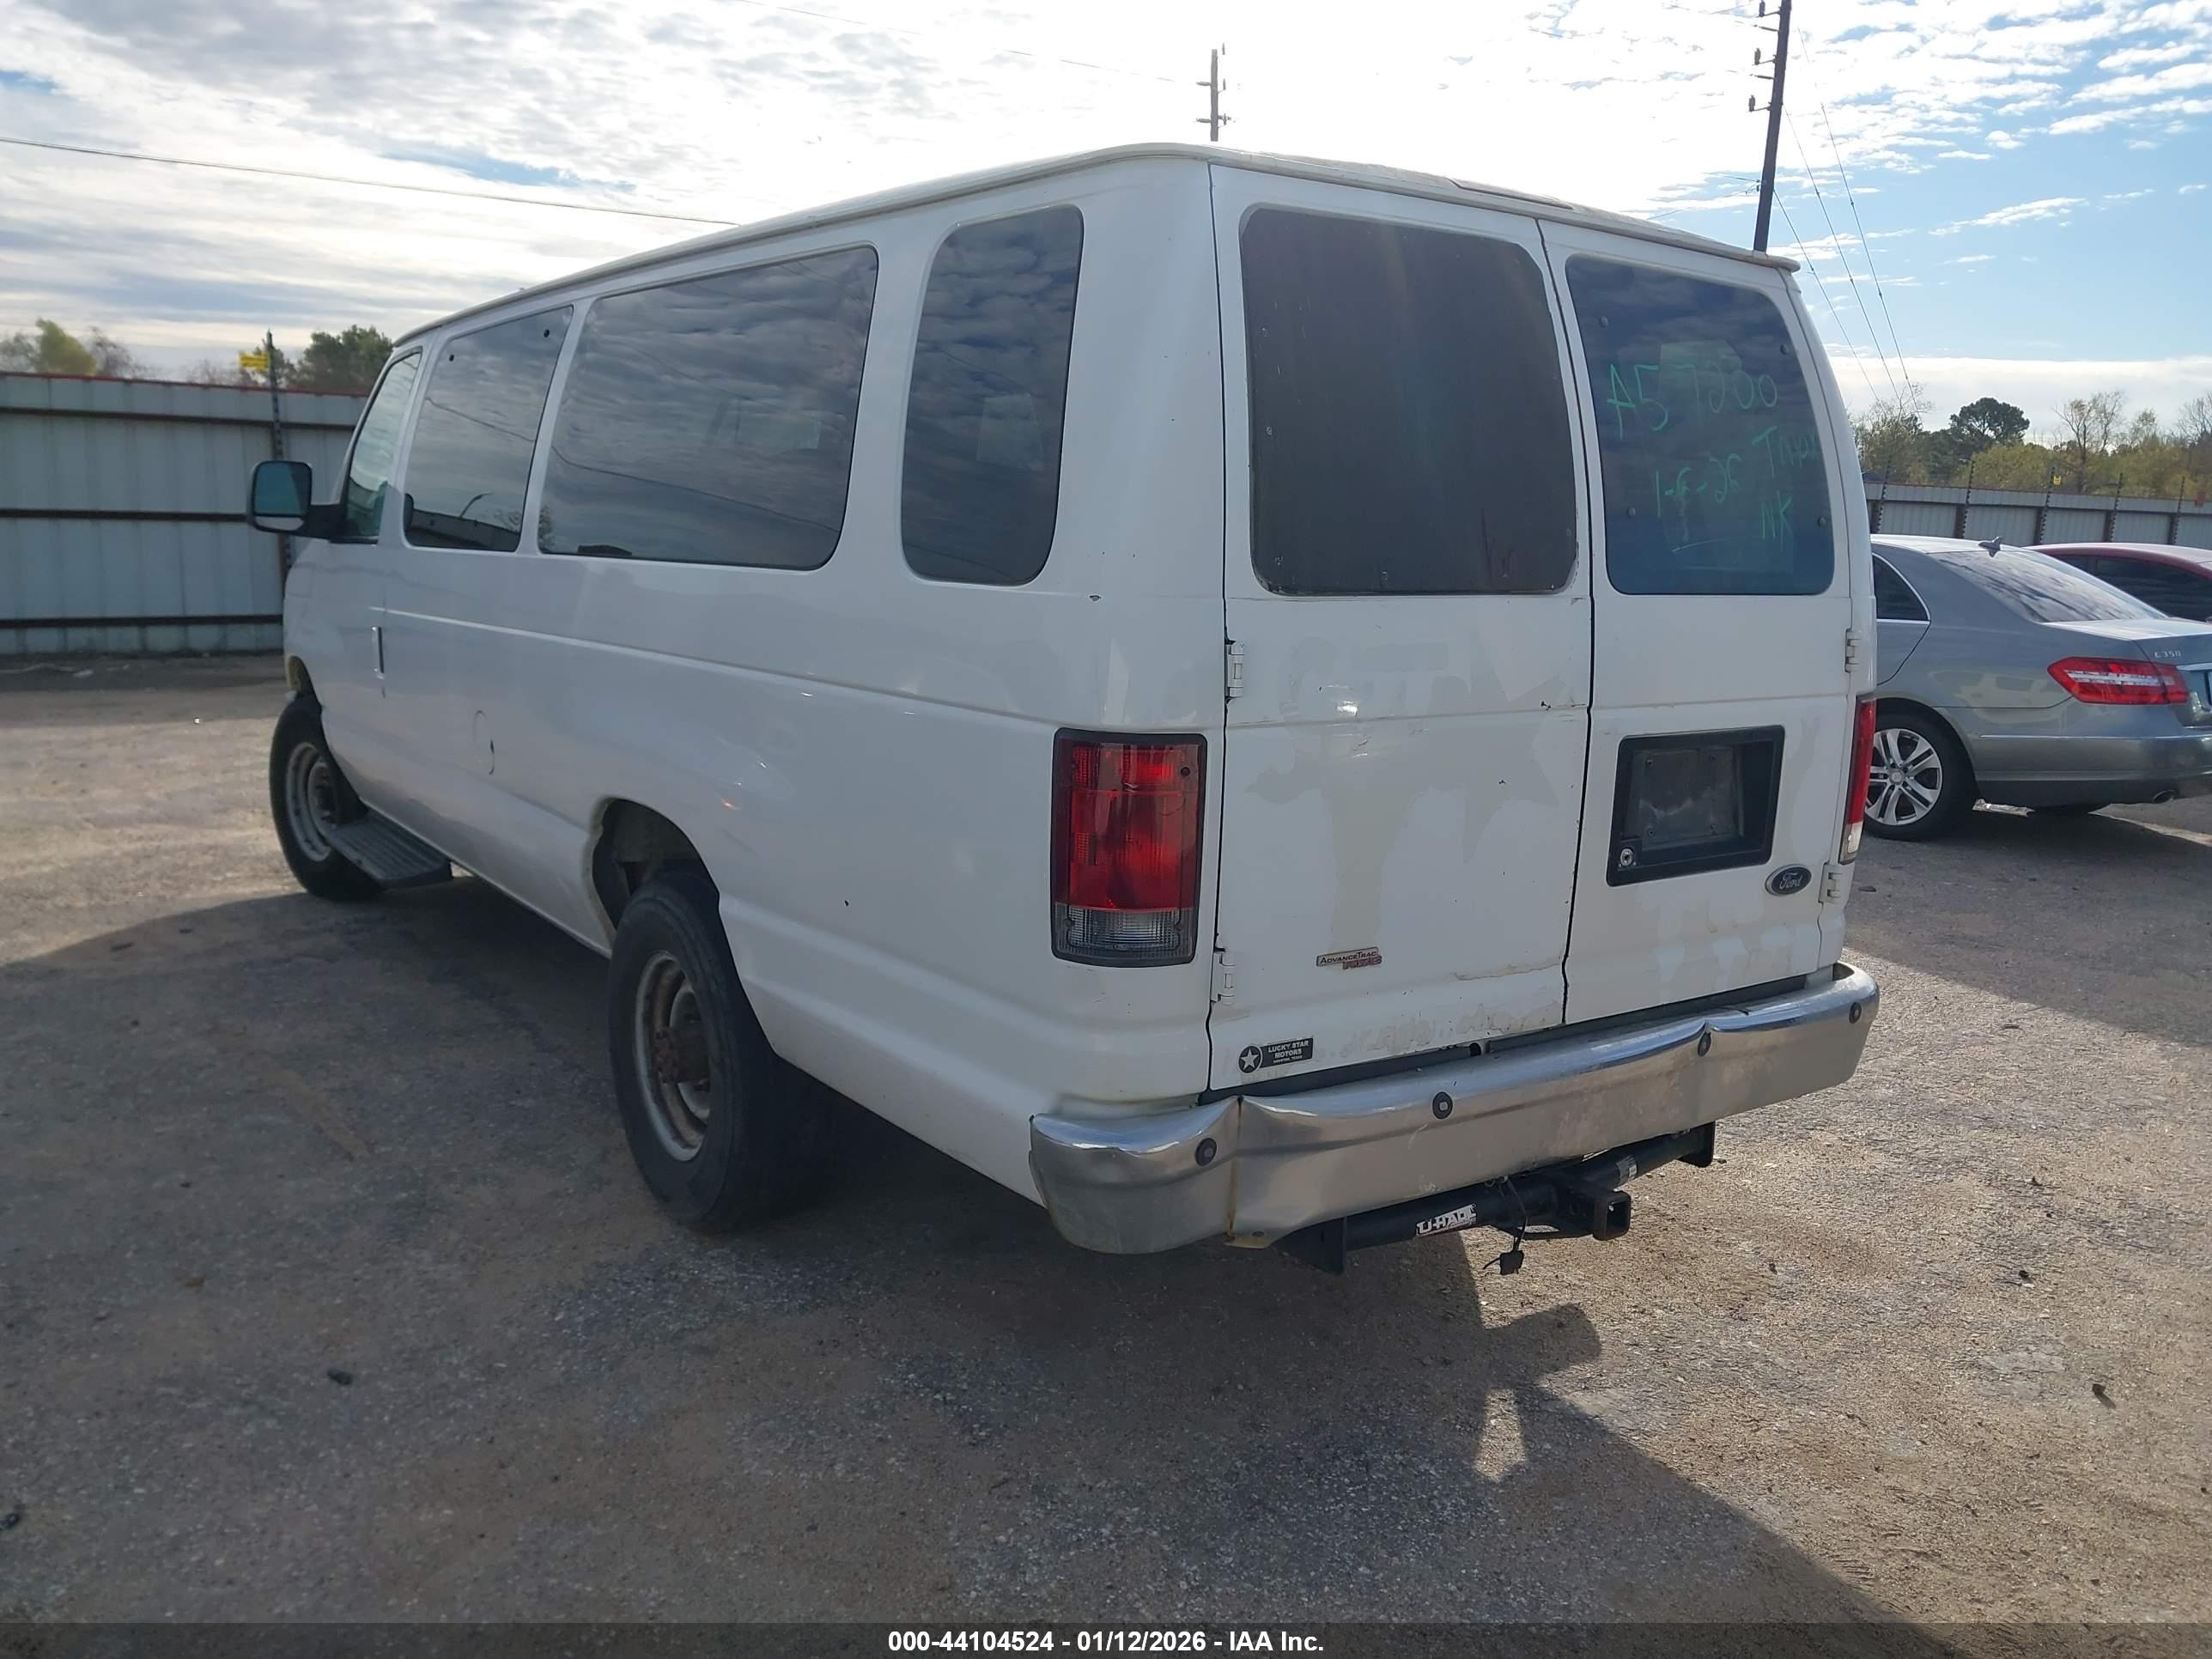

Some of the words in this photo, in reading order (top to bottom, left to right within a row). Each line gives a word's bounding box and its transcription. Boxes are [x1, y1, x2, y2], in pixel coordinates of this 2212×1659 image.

[1778, 872, 1803, 890] Ford
[1267, 1043, 1291, 1053] LUCKY
[1291, 1040, 1310, 1049] STAR
[1274, 1048, 1302, 1059] MOTORS
